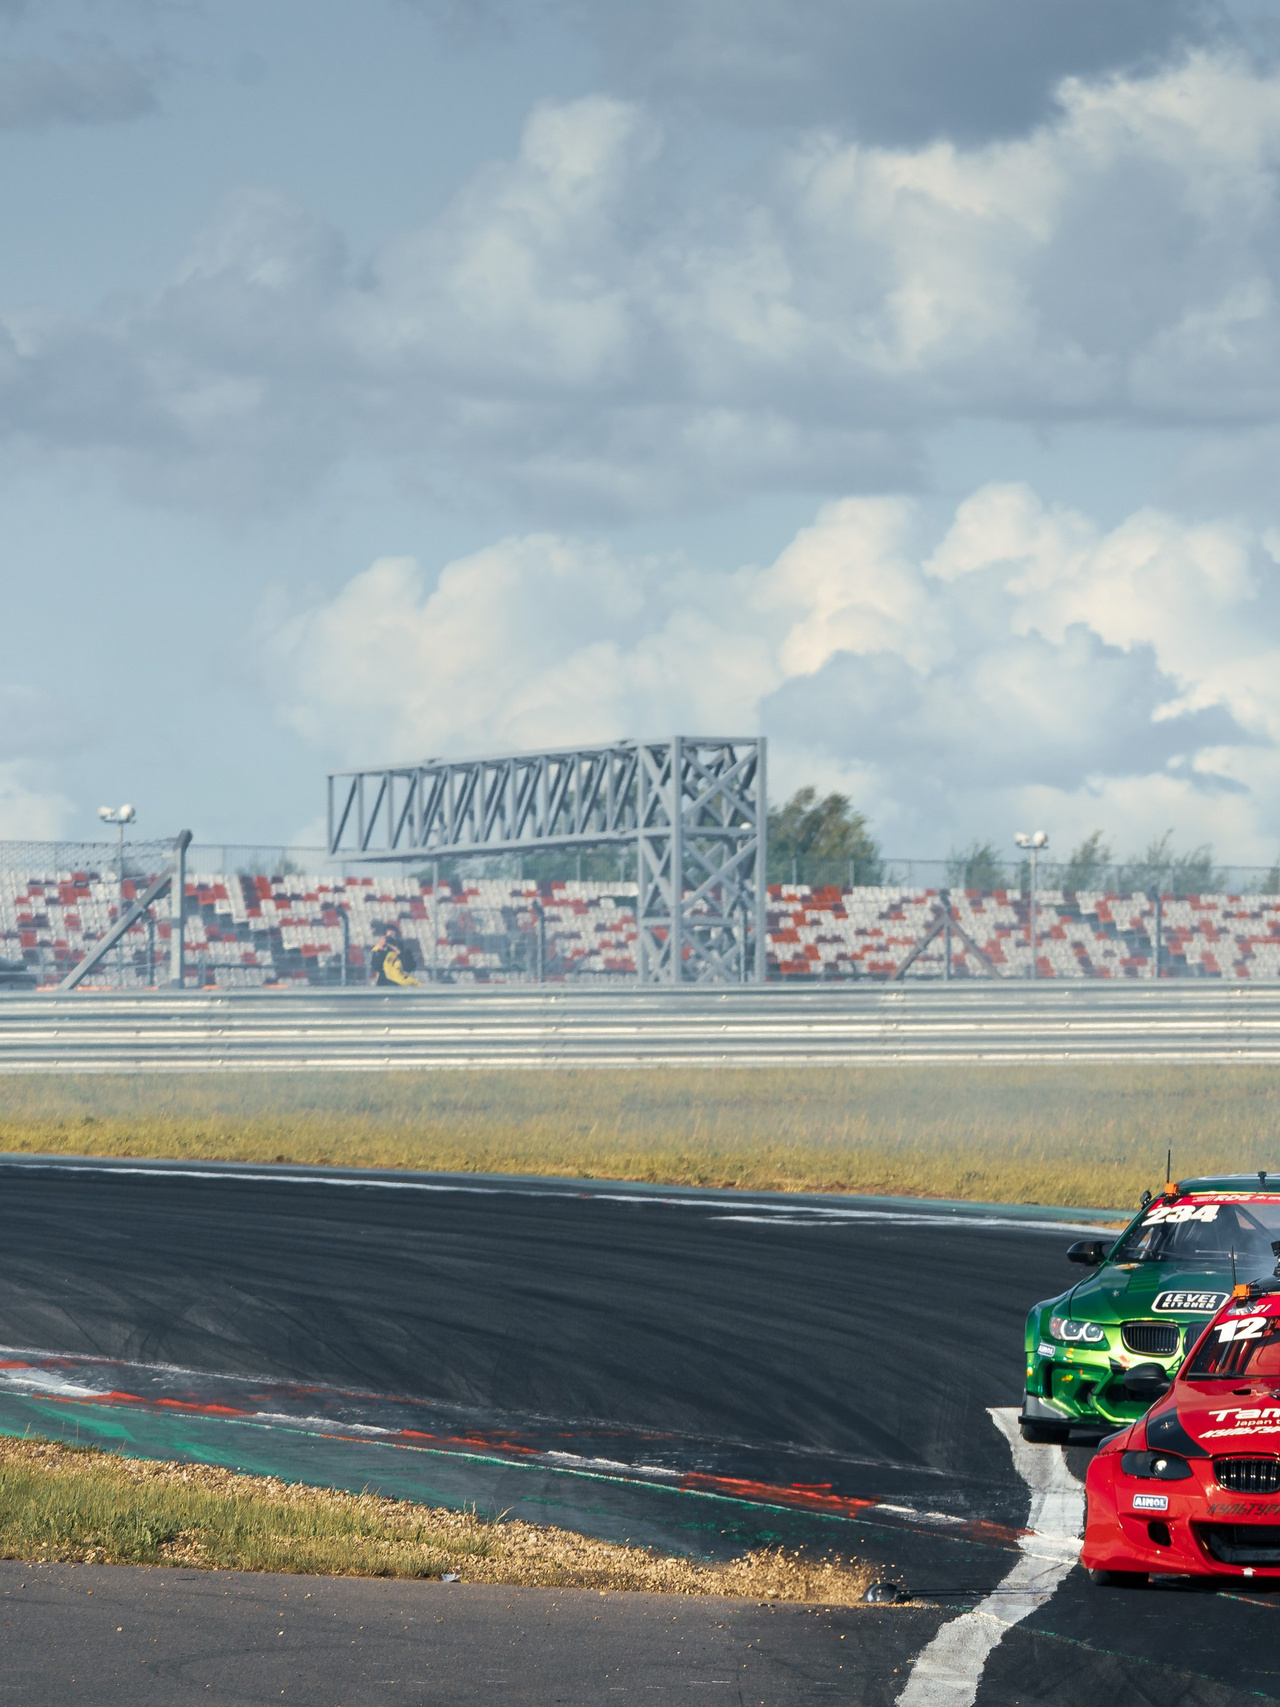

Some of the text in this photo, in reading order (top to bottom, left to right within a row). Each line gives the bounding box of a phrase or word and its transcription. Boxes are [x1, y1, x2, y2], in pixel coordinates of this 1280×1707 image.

[1141, 1204, 1221, 1227] 234
[1165, 1293, 1218, 1304] LEVEL
[1162, 1301, 1215, 1309] KITCHEN
[1214, 1316, 1267, 1343] 12
[1135, 1497, 1166, 1508] AIMOL
